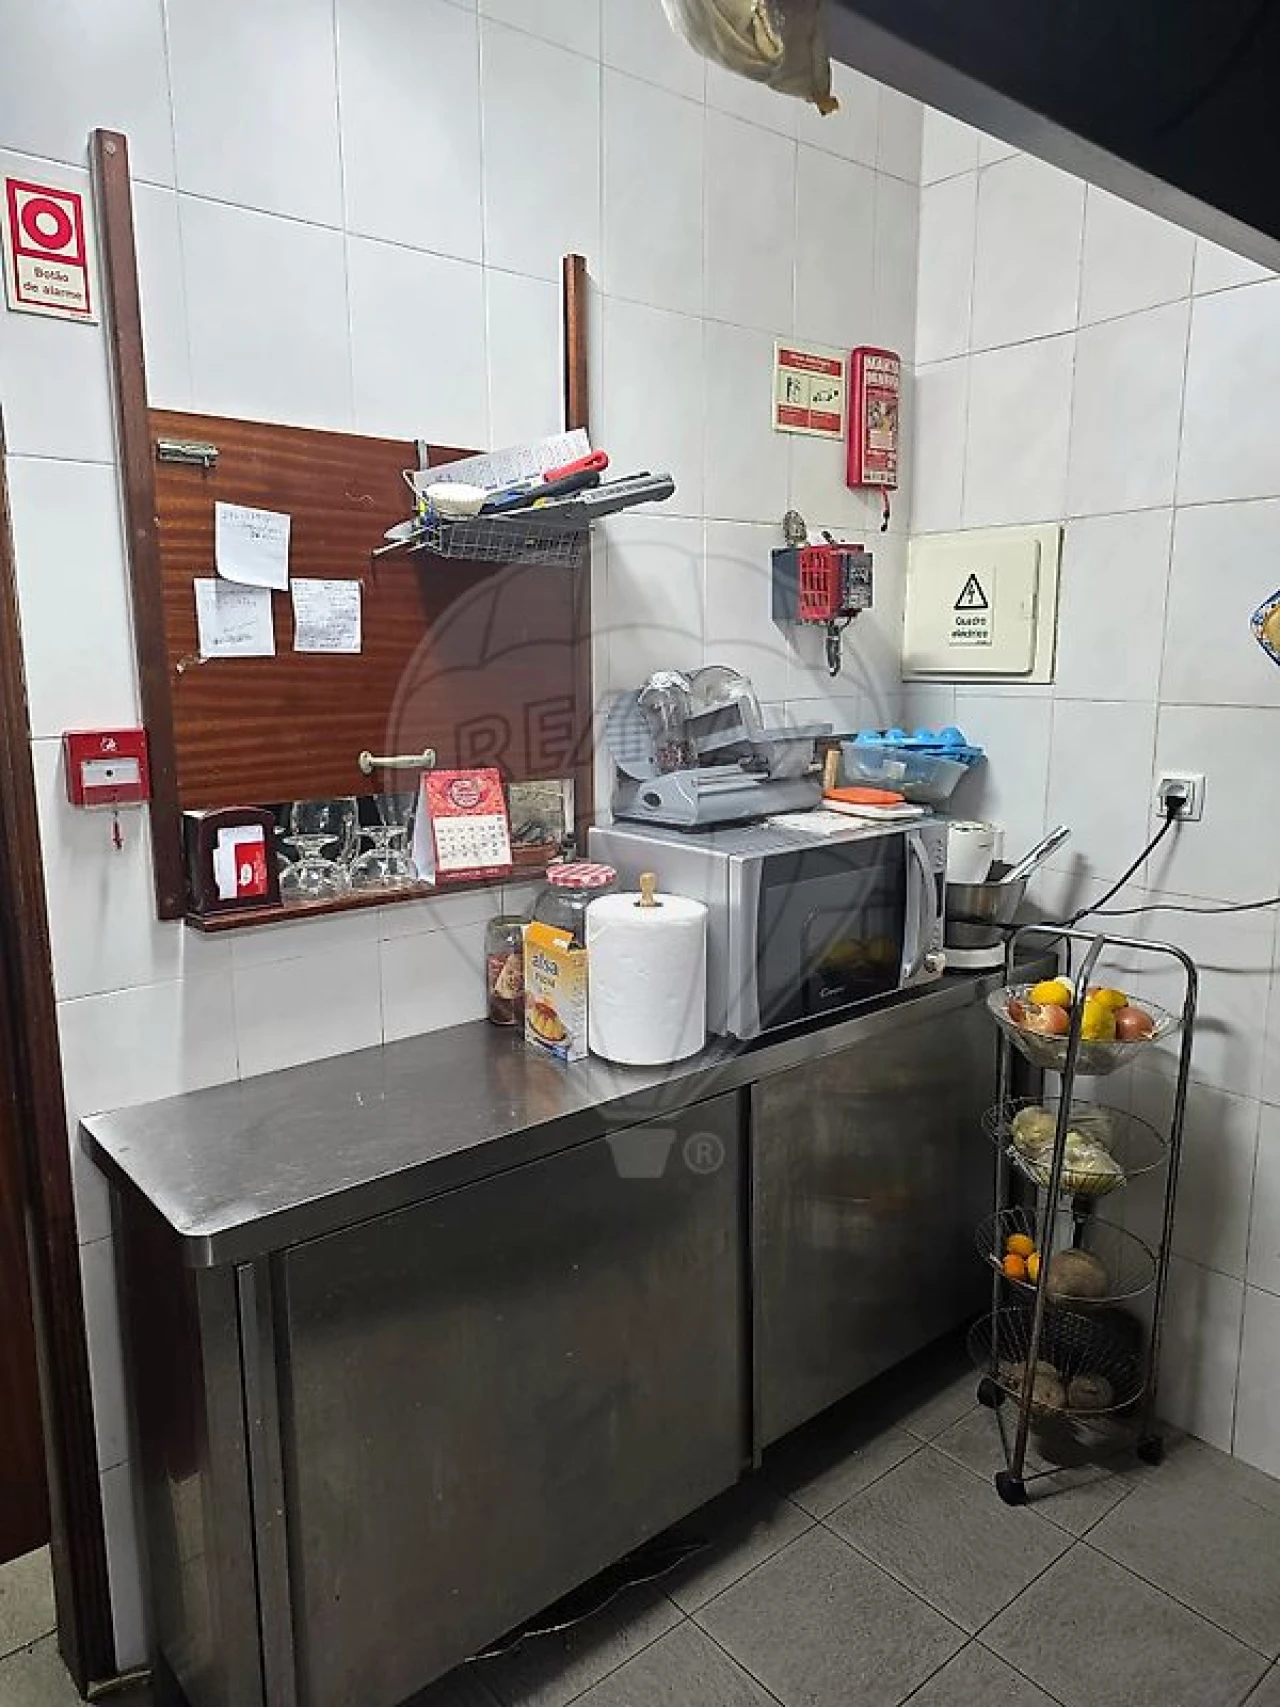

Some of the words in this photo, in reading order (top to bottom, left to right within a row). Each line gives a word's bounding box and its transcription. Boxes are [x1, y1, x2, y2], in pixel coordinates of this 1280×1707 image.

[33, 266, 69, 282] Botão
[23, 282, 39, 293] de
[42, 285, 82, 301] alarme
[955, 616, 987, 626] Quadro
[531, 953, 558, 976] alsa
